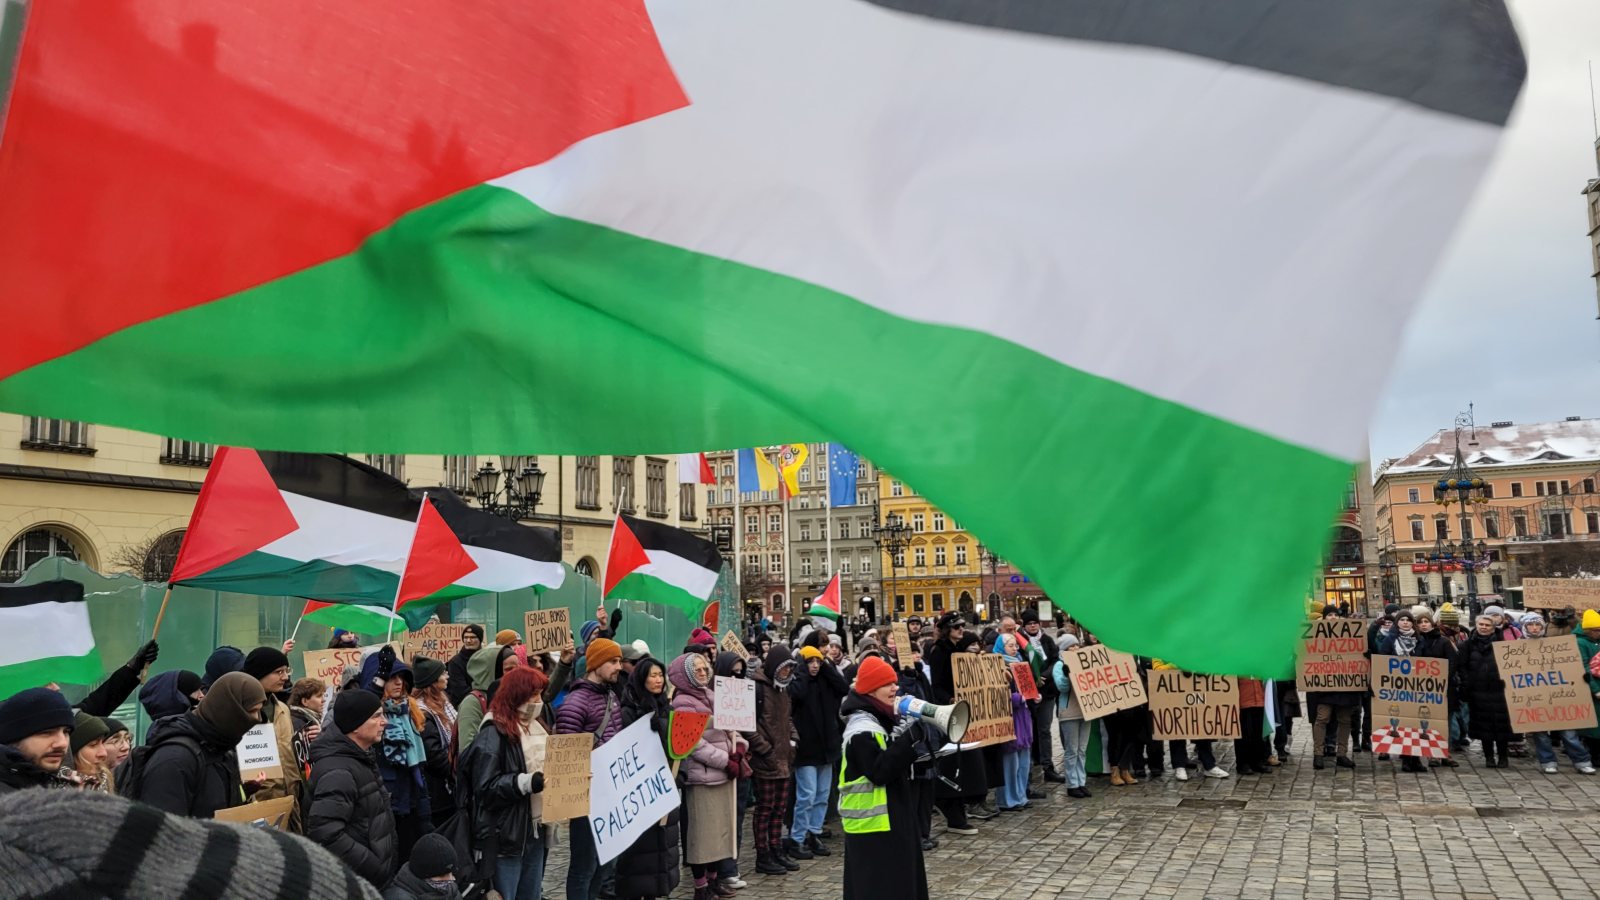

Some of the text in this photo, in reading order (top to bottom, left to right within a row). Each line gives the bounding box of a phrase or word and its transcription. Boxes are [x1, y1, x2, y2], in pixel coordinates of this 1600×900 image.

[528, 609, 567, 627] ISRAEL BOMBS
[408, 626, 463, 639] WAR CRIMI
[1300, 621, 1364, 639] ZAKAZ
[421, 640, 461, 650] ARE NOT
[530, 626, 568, 652] LEBANON
[1305, 639, 1365, 654] WJAZDU
[1077, 647, 1110, 670] BAN
[1304, 660, 1370, 674] ZBRODNIARZY
[722, 680, 746, 695] STOP
[1156, 672, 1231, 693] ALL EYES
[1303, 674, 1369, 687] WOJENNYCH
[1380, 675, 1446, 693] PIONKÓW
[721, 695, 746, 711] GAZA
[1080, 680, 1141, 714] PRODUCTS
[1185, 693, 1206, 705] ON
[1379, 689, 1443, 704] SYJONIZMU
[1152, 704, 1240, 737] NORTH GAZA
[1516, 703, 1591, 725] ZNIEWOLONY
[245, 742, 269, 750] MORDUJE
[244, 755, 274, 764] NOWORODKI
[609, 742, 646, 790] FREE
[592, 765, 672, 845] PALESTINE
